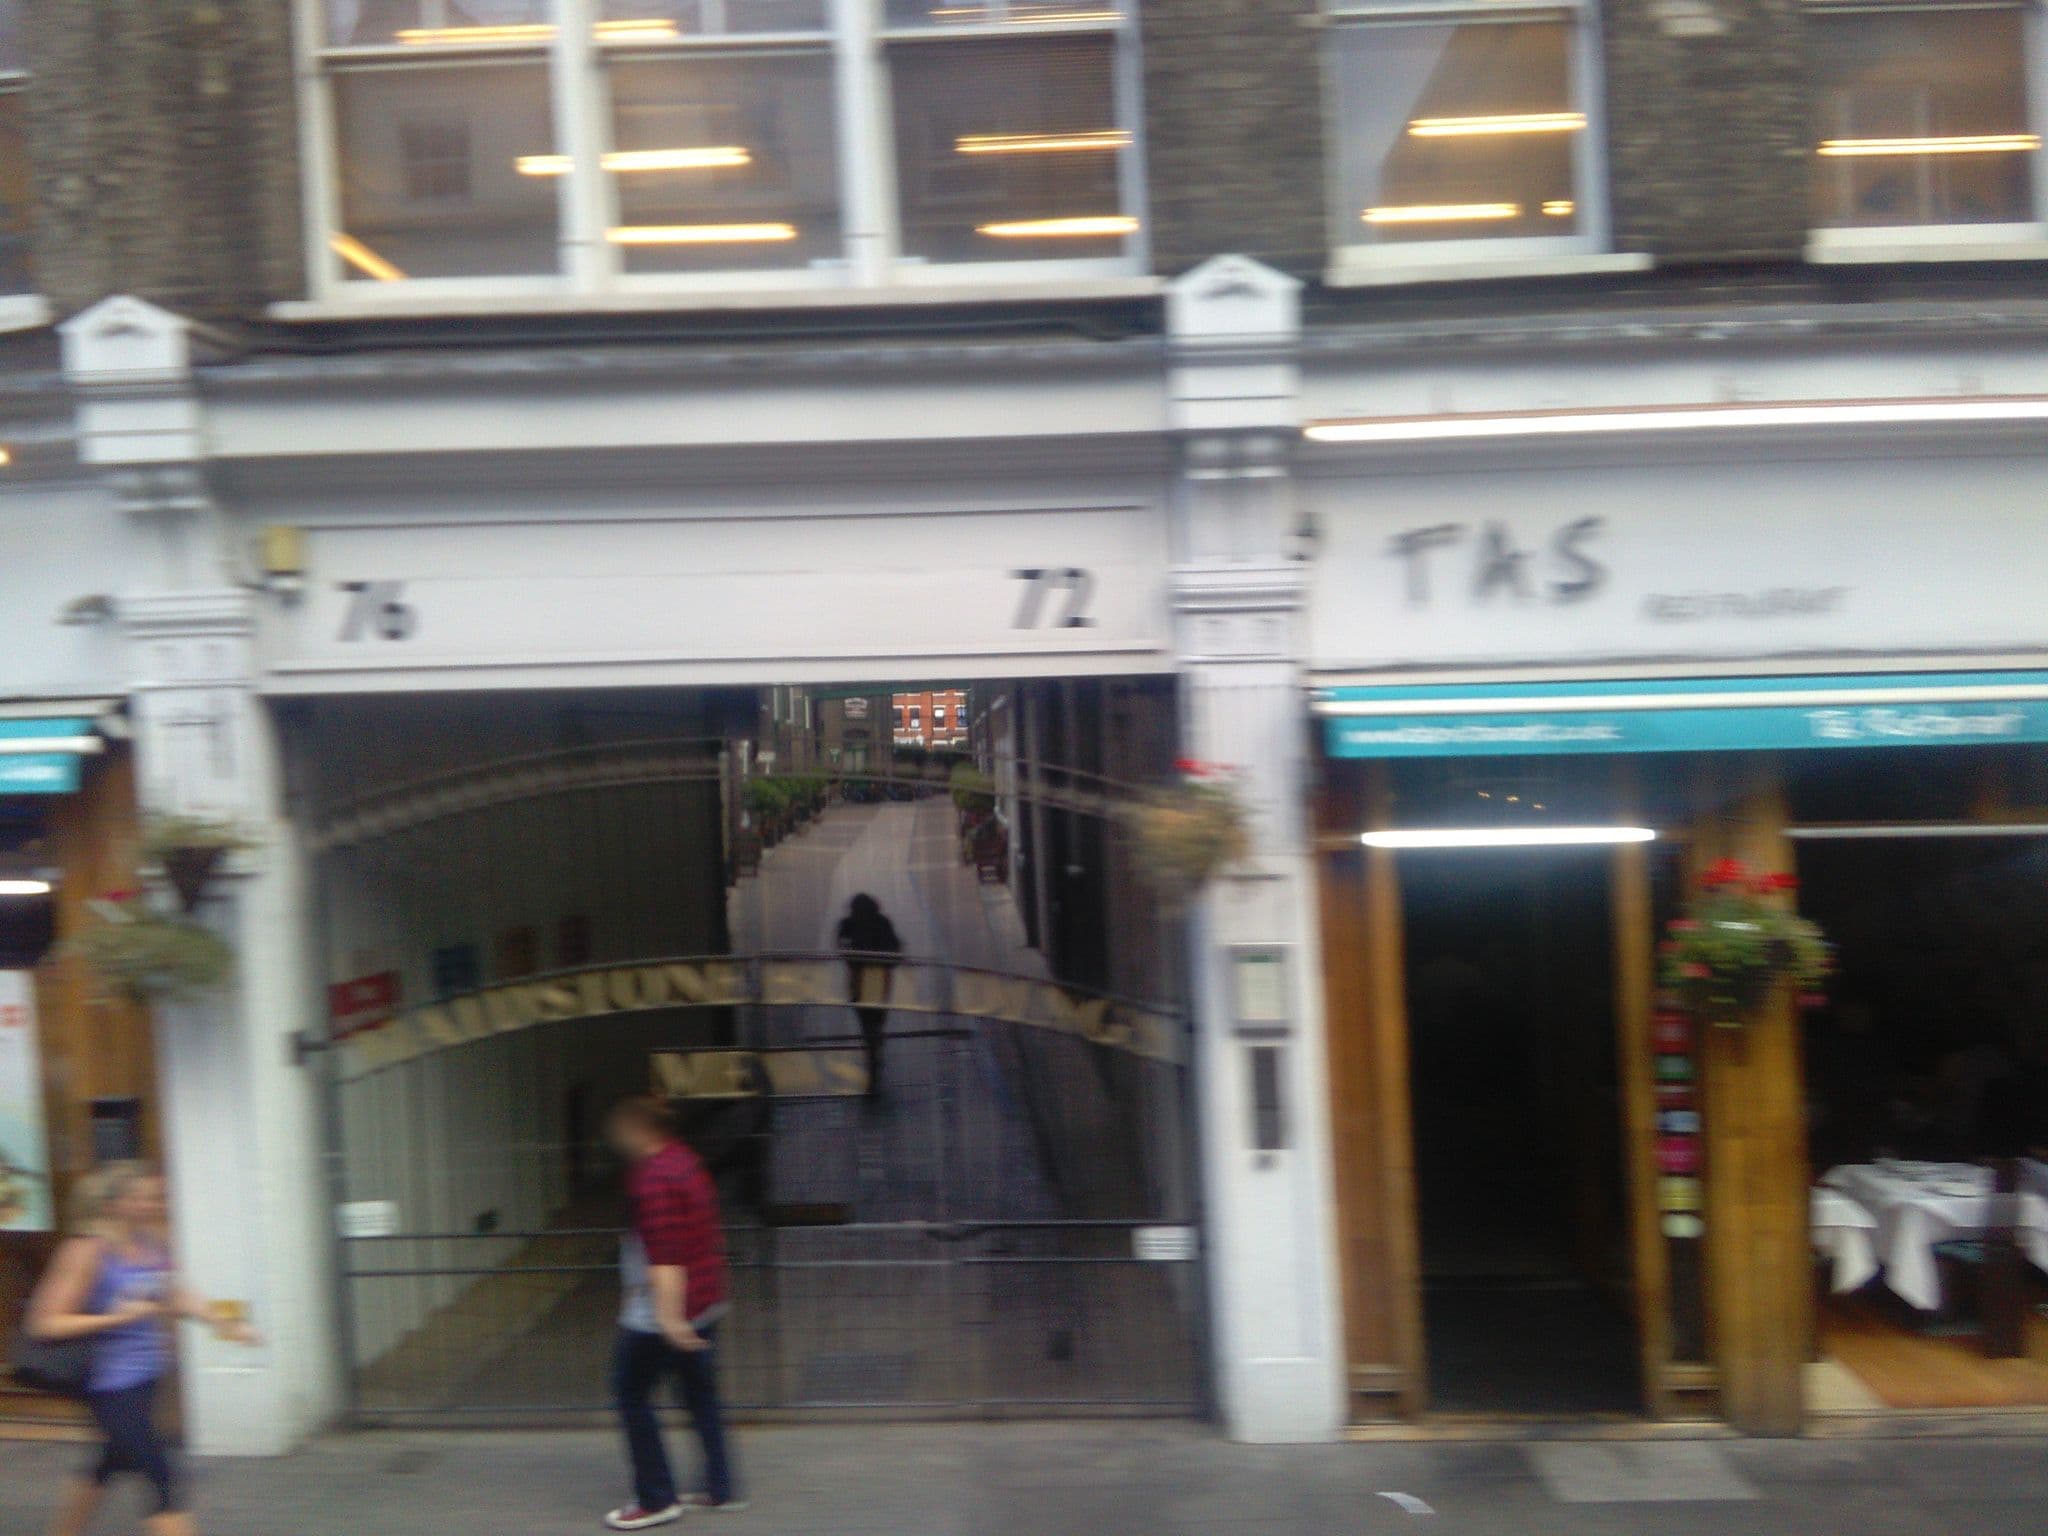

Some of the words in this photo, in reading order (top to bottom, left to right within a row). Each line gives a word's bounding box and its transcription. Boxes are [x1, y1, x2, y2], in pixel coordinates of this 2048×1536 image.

[1388, 515, 1608, 608] TAS
[334, 580, 419, 641] 76
[1010, 567, 1097, 629] 72
